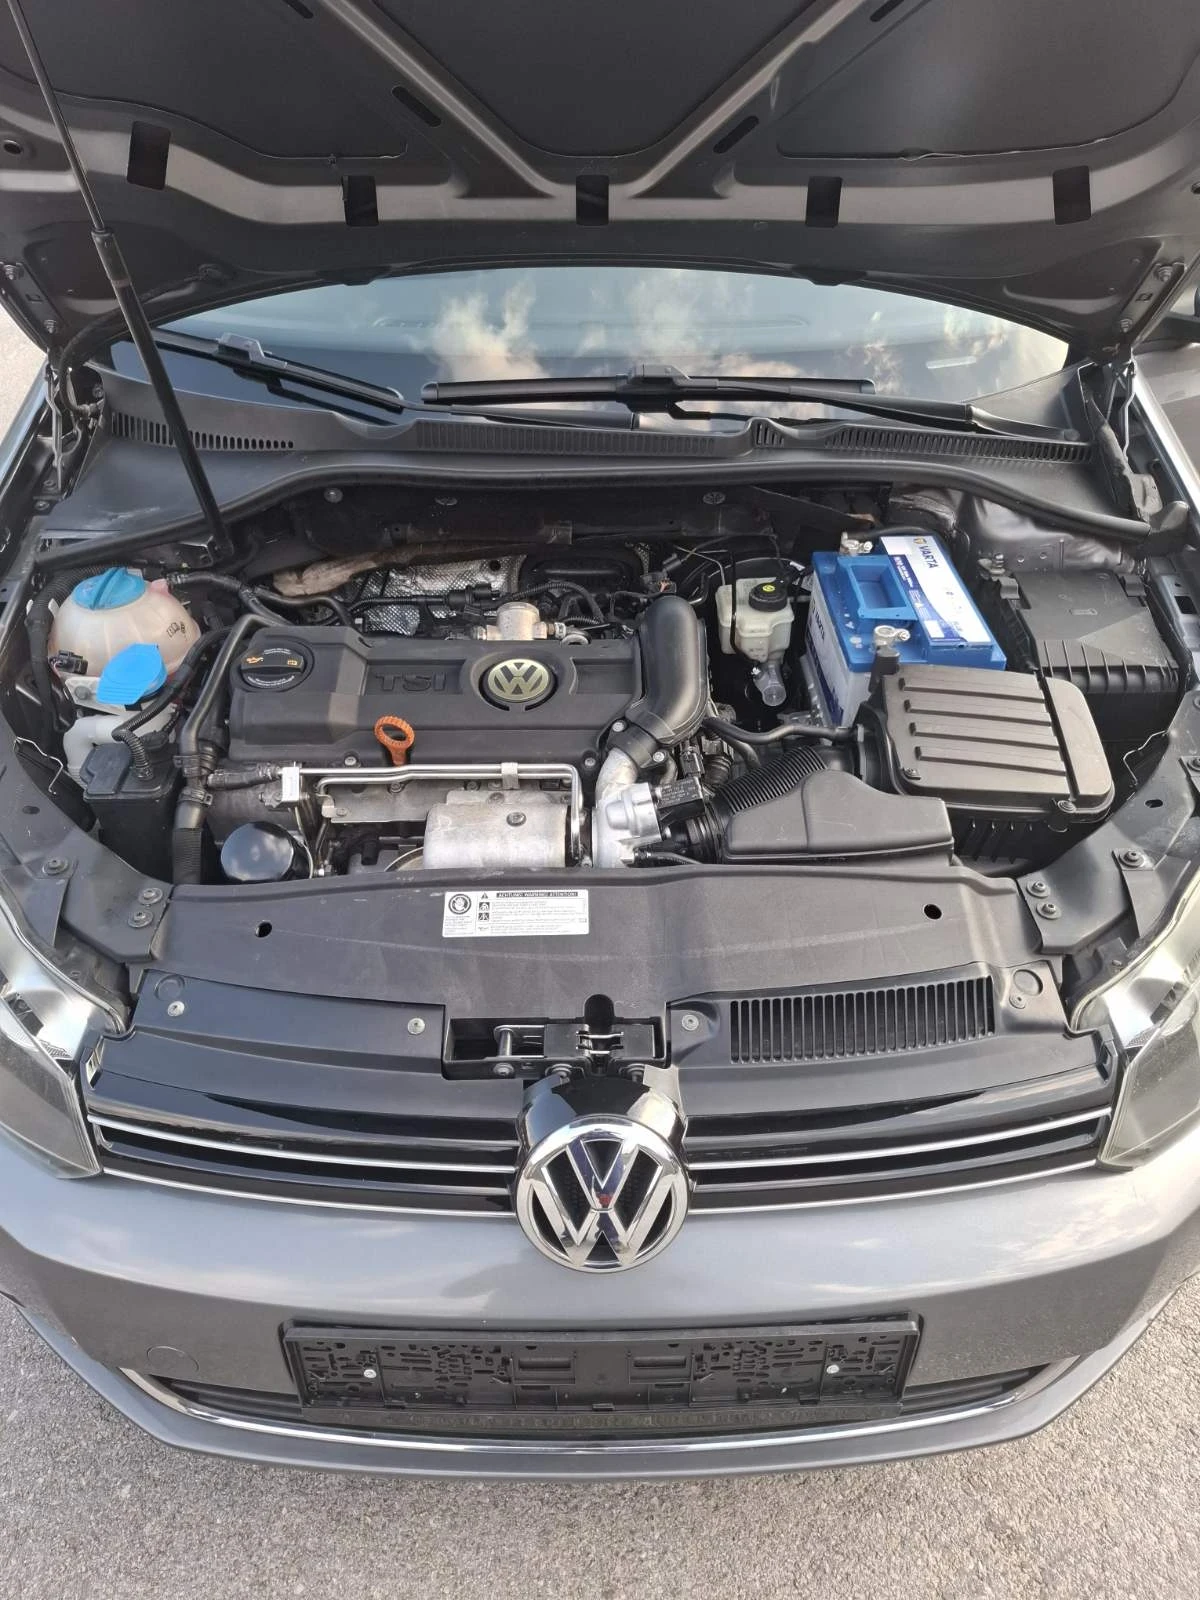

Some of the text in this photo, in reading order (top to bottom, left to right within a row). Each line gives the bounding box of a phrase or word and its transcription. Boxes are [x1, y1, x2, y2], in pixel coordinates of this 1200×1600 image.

[919, 545, 939, 569] VARTA
[375, 672, 447, 692] TSI
[487, 659, 550, 701] VW
[517, 1114, 688, 1274] VW
